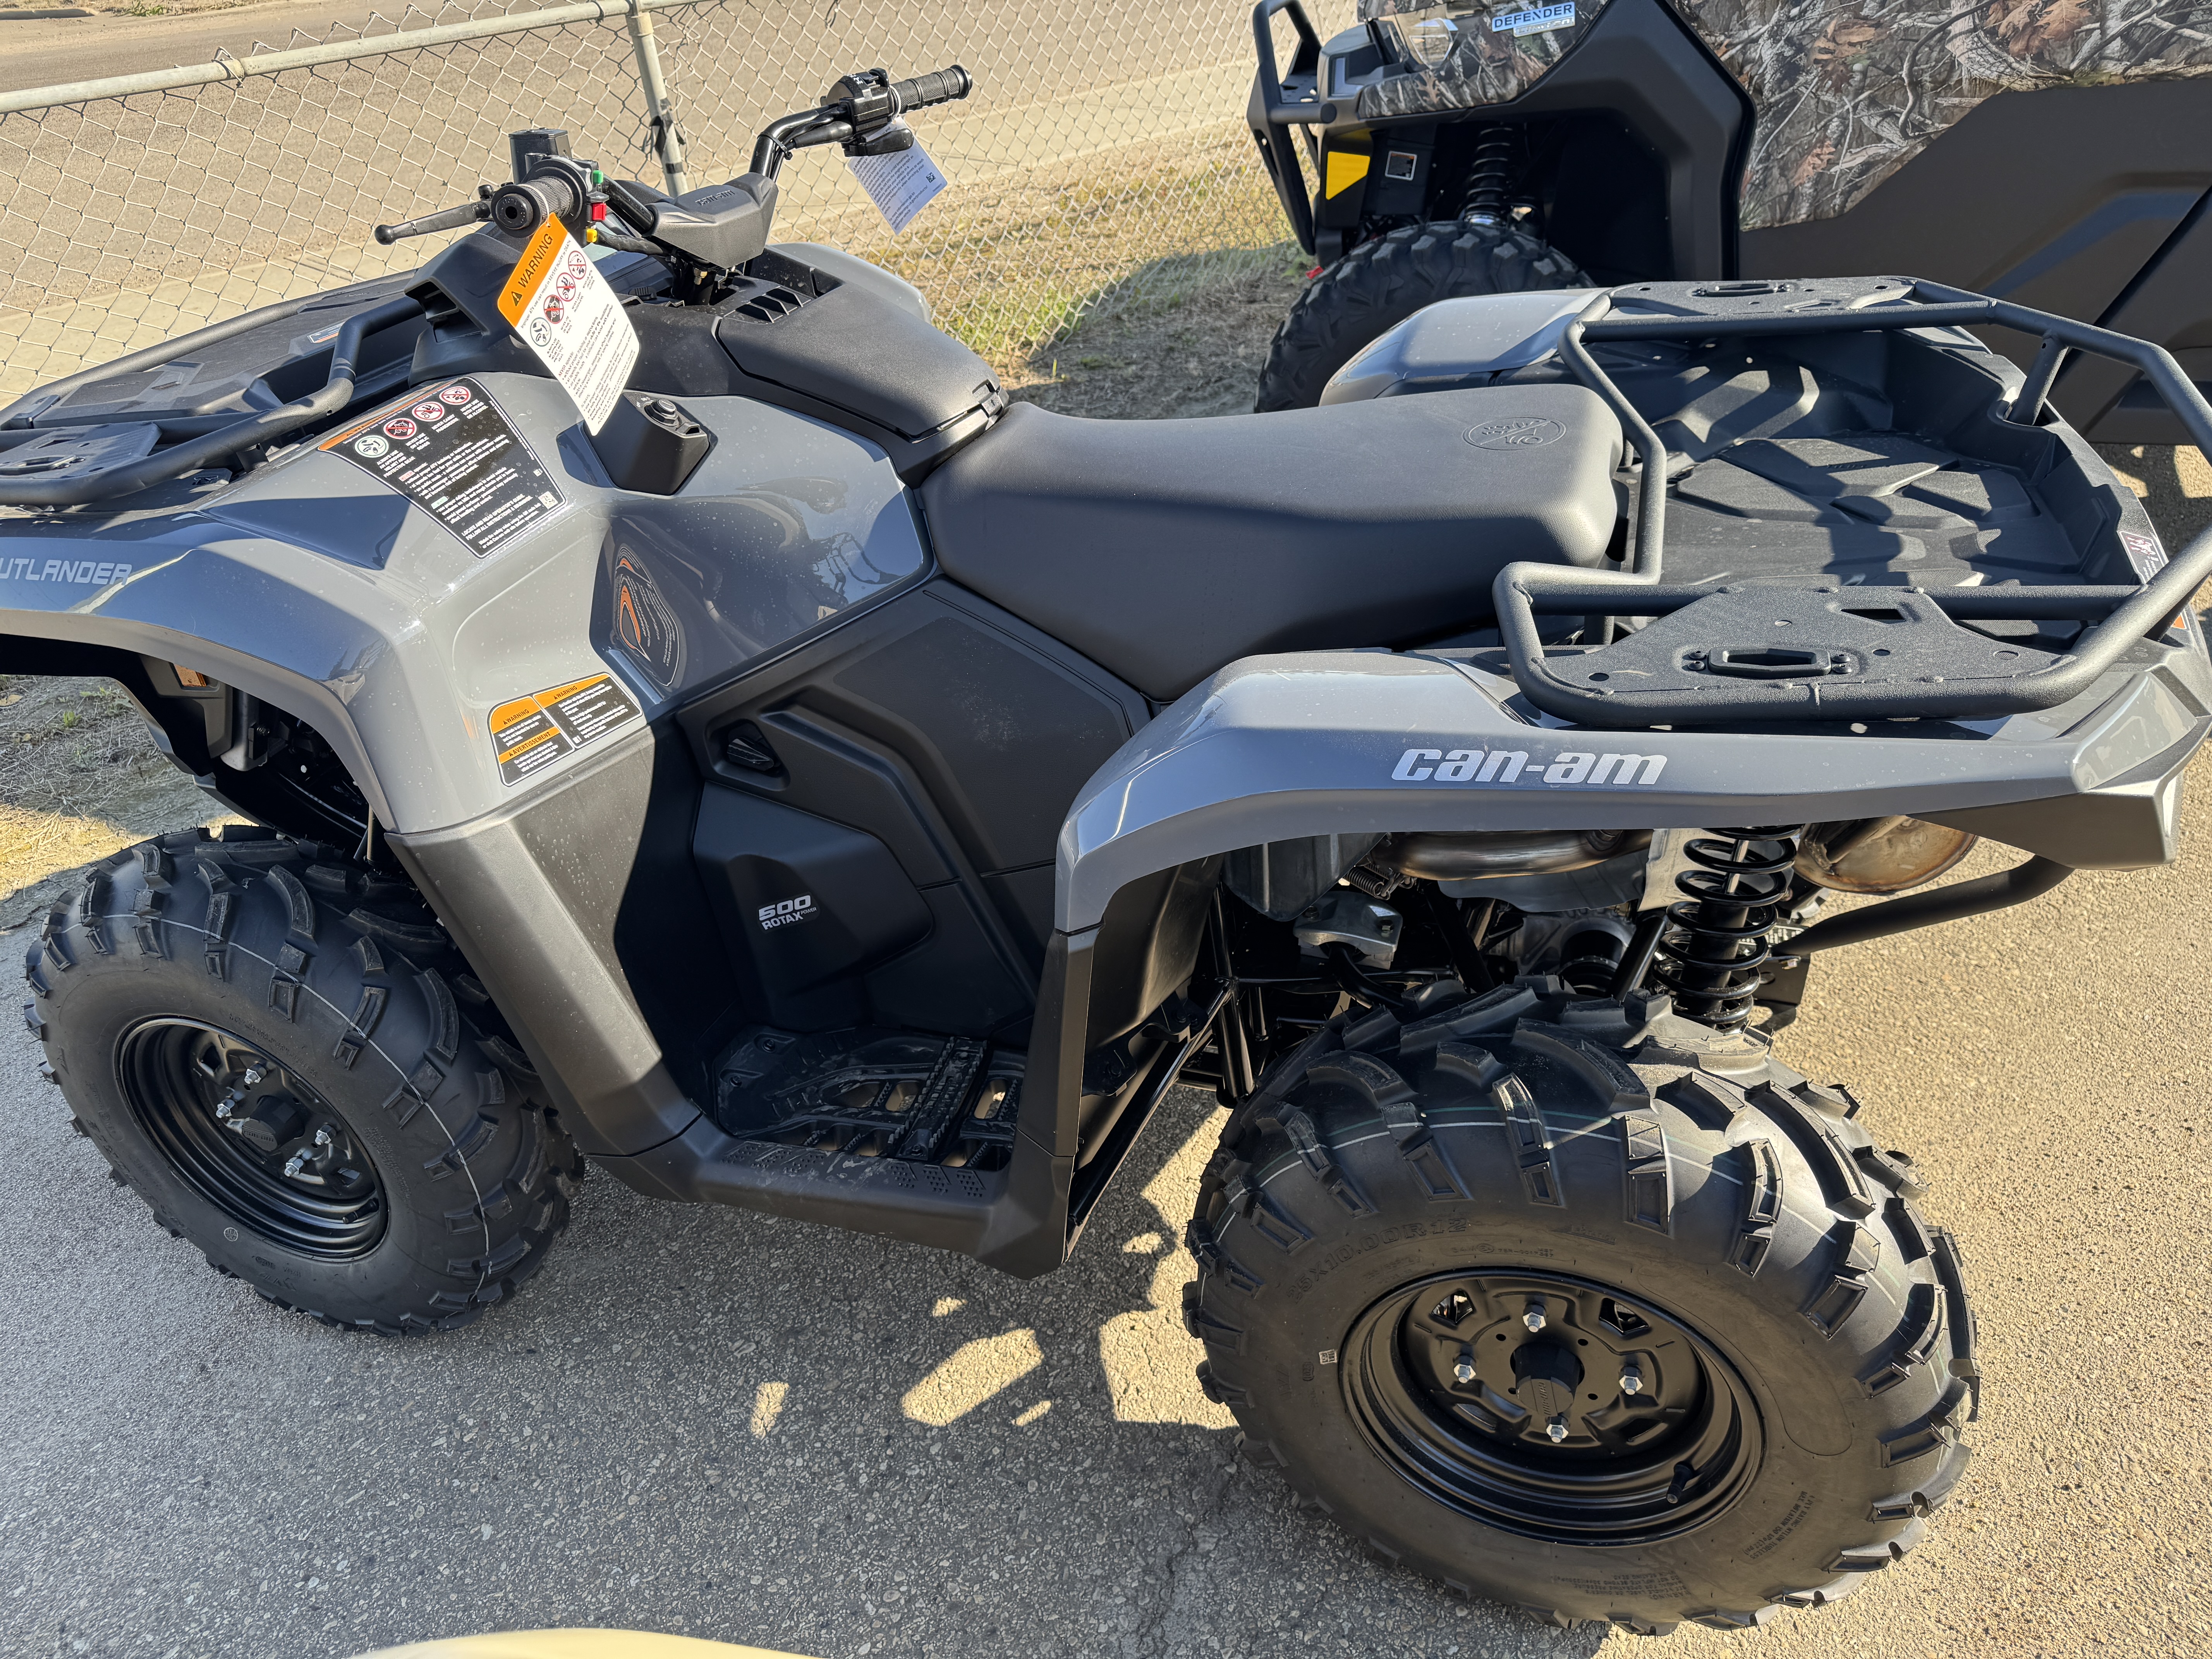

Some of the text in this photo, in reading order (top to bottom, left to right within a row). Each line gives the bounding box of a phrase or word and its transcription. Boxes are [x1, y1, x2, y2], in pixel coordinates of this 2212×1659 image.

[1495, 5, 1572, 28] DEFENDER
[517, 233, 553, 288] WARNING
[556, 685, 577, 699] WARNING
[506, 709, 529, 723] WARNING
[513, 732, 551, 754] AVERTISSEMENT
[759, 895, 811, 921] 500
[761, 907, 817, 931] ROTAX POWER
[1804, 1499, 1814, 1510] PLY
[1780, 1503, 1801, 1527] INFLATION
[1790, 1510, 1807, 1528] RATING
[1776, 1527, 1794, 1542] NYLON
[1749, 1541, 1778, 1560] TUBELESS
